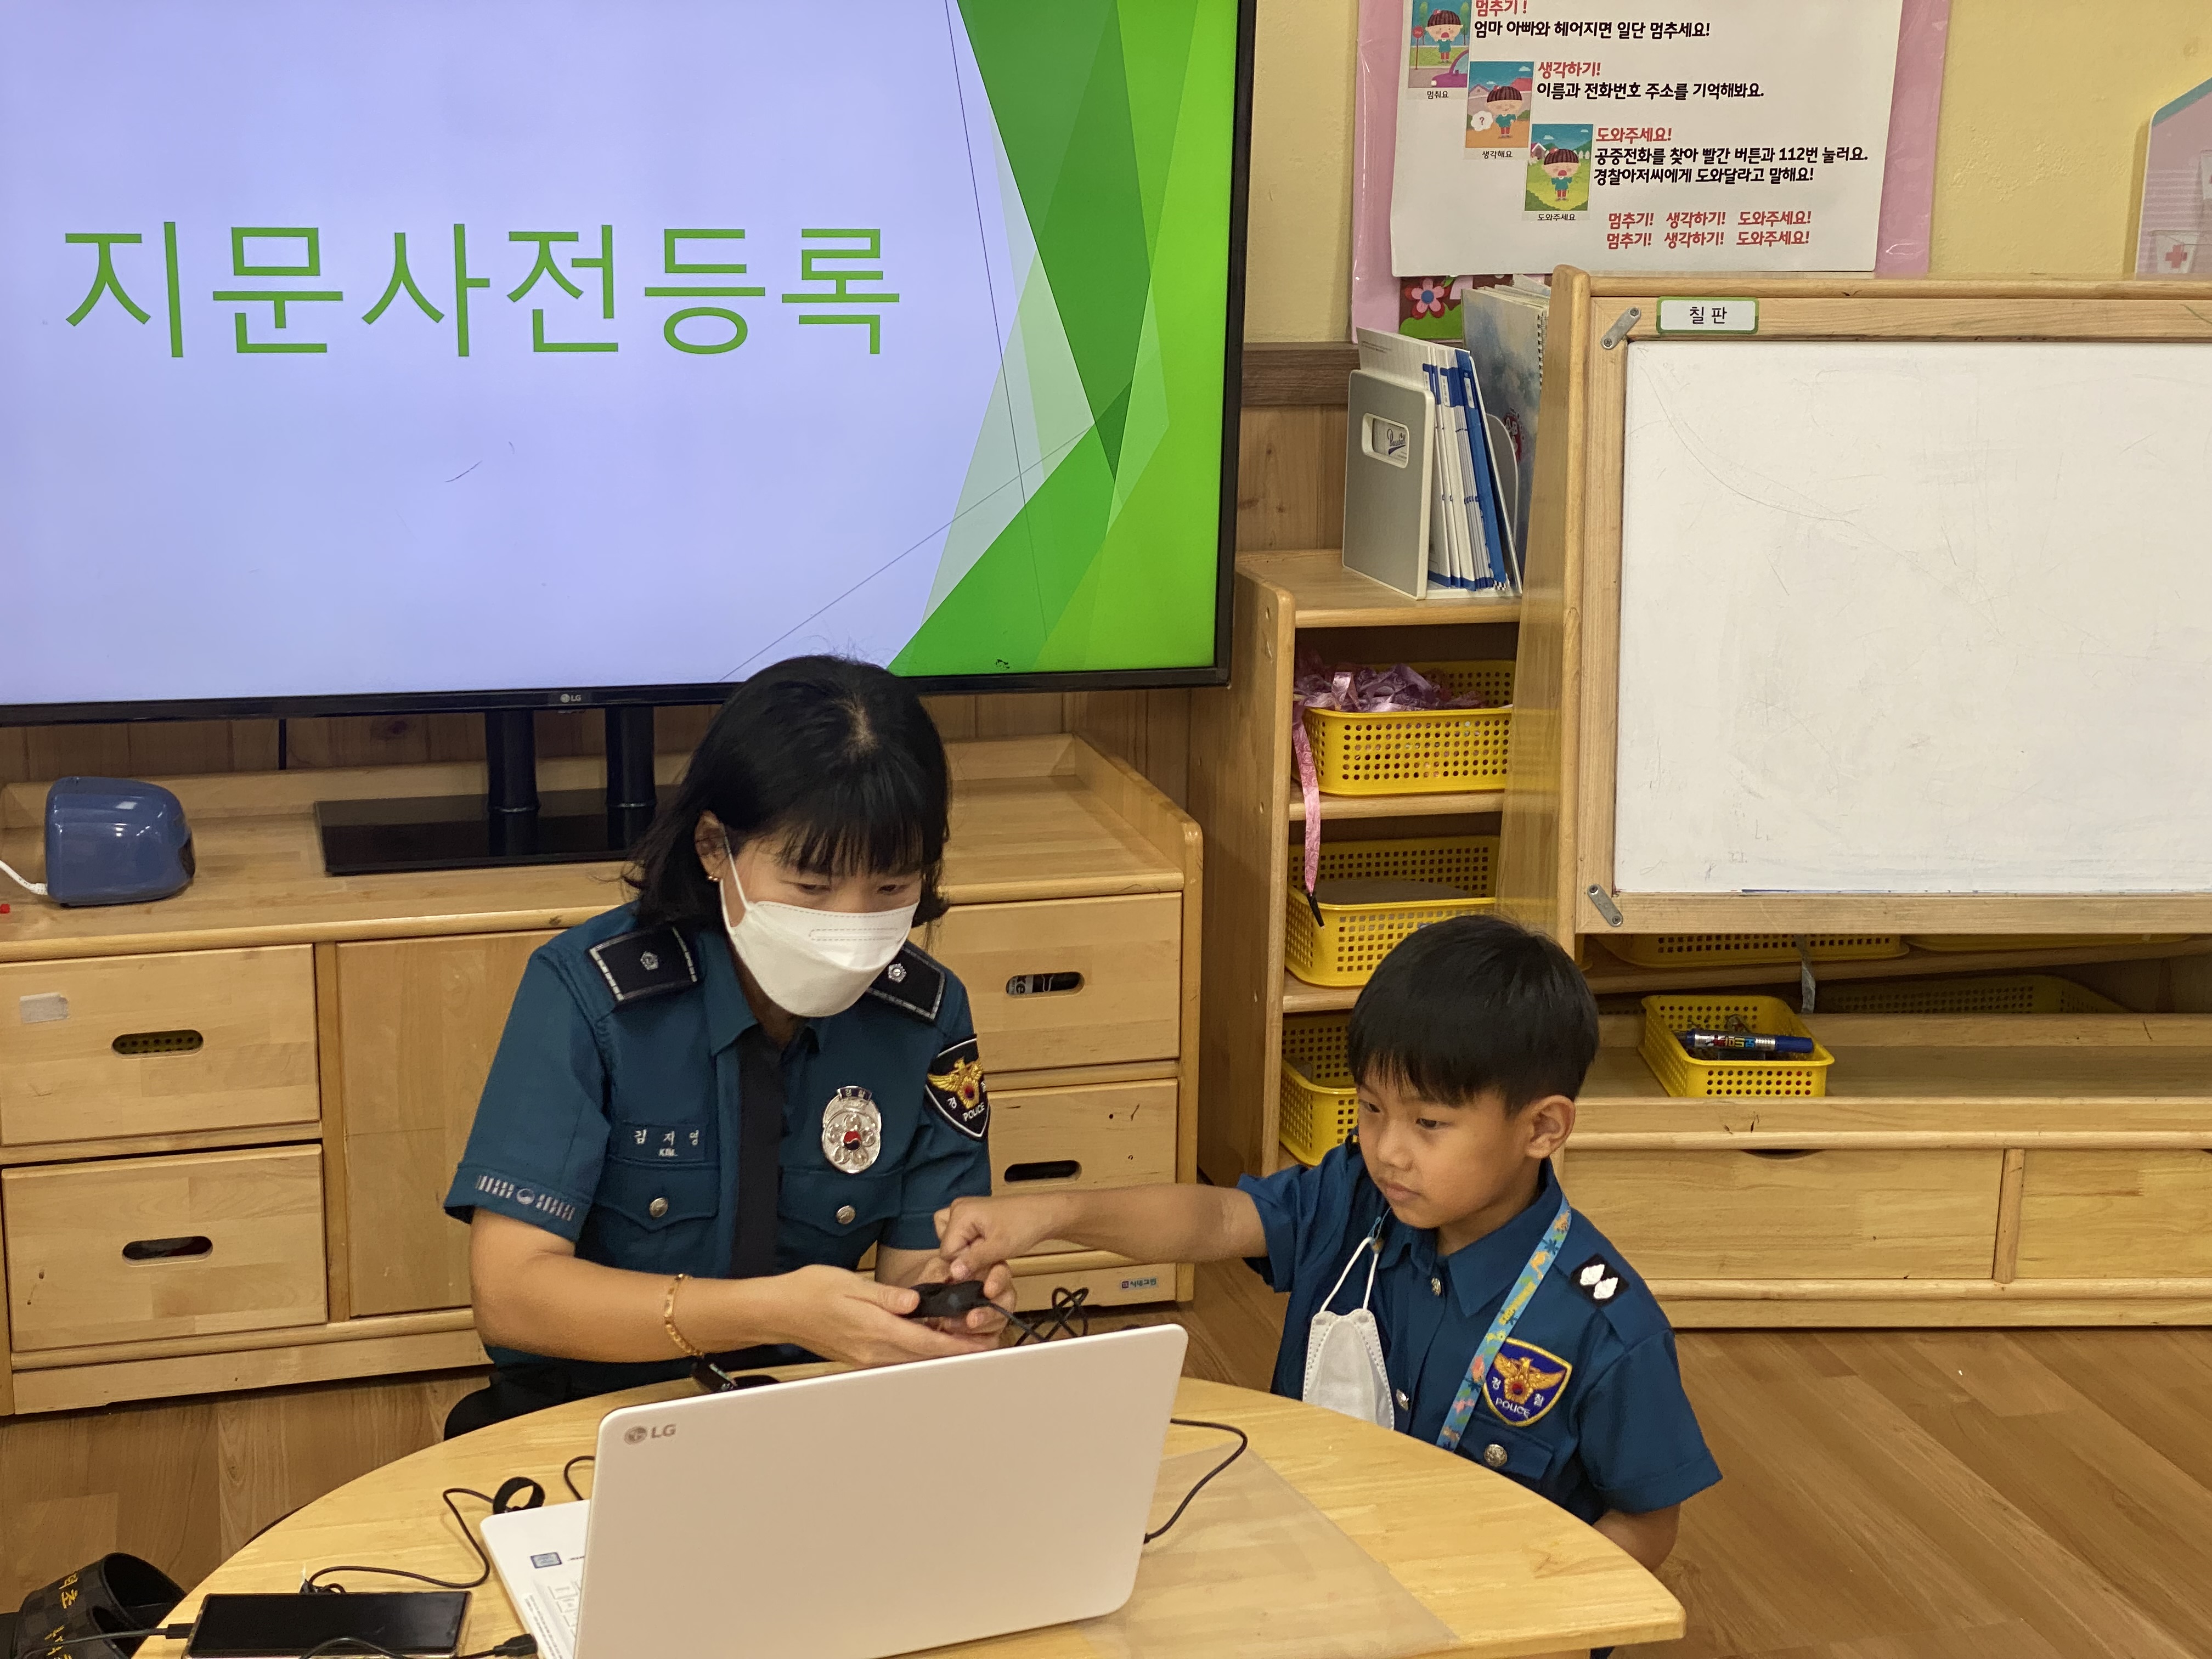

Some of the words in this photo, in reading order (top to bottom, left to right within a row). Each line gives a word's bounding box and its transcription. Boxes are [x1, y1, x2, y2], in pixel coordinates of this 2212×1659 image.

[1476, 0, 1517, 16] 멈추기
[1475, 21, 1503, 38] 엄마
[1506, 21, 1550, 37] 아빠와
[1554, 21, 1612, 38] 헤어지면
[1618, 22, 1646, 39] 일단
[1650, 22, 1709, 39] 멈추세요!
[1538, 61, 1600, 79] 생각하기!
[1537, 83, 1581, 99] 이름과
[1584, 82, 1641, 99] 전화번호
[1645, 83, 1688, 100] 주소를
[1693, 83, 1764, 100] 기억해봐요.
[1596, 127, 1672, 144] 도와주세요!
[1482, 150, 1513, 159] 생각해요
[1595, 147, 1666, 165] 공중전화를
[1670, 148, 1699, 165] 찾아
[1703, 148, 1730, 165] 빨간
[1735, 148, 1775, 164] 버튼과
[1779, 147, 1818, 163] 112번
[1822, 147, 1867, 163] 눌러요.
[1594, 168, 1692, 185] 경찰아저씨에게
[1695, 168, 1764, 184] 도와달라고
[1770, 167, 1813, 184] 말해요!
[1609, 212, 1654, 229] 멈추기!
[1666, 212, 1725, 229] 생각하기!
[1738, 211, 1811, 227] 도와주세요!
[1607, 233, 1651, 249] 멈추기!
[1664, 232, 1724, 249] 생각하기!
[1736, 231, 1809, 247] 도와주세요!
[65, 222, 899, 358] 지문사전등록
[963, 1102, 985, 1122] POLICE
[1496, 1397, 1531, 1420] POLICE
[651, 1423, 677, 1438] LG
